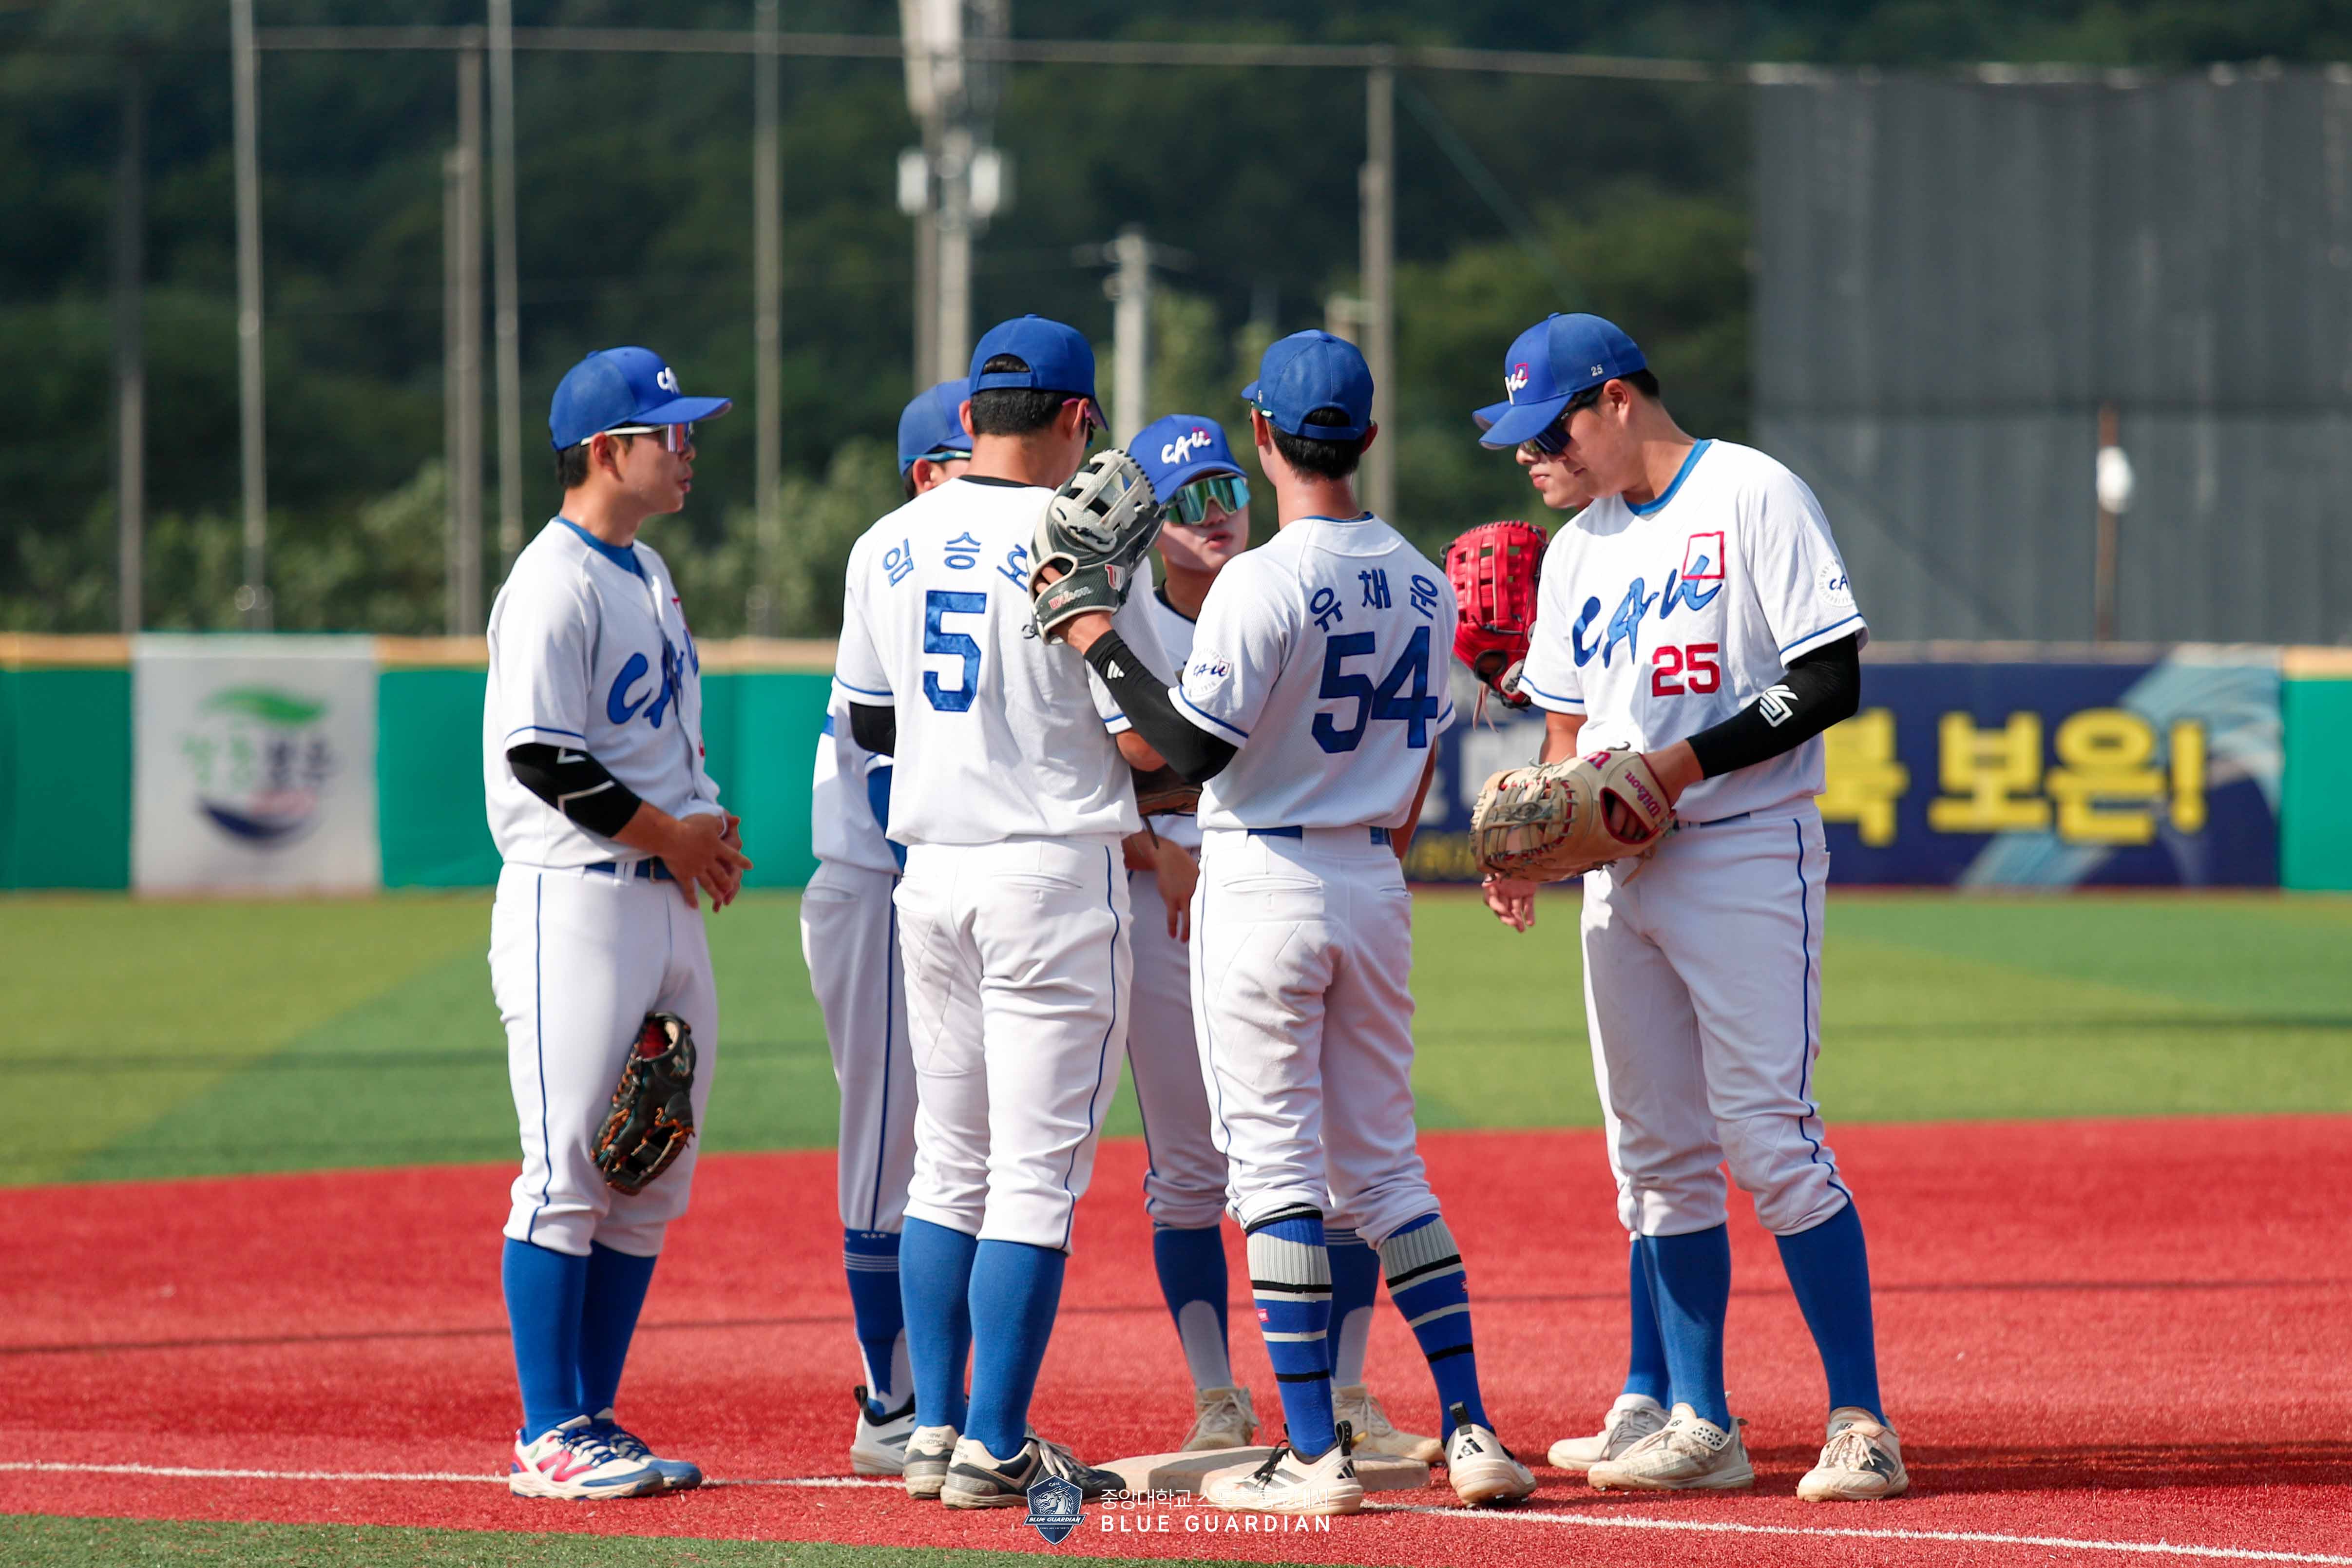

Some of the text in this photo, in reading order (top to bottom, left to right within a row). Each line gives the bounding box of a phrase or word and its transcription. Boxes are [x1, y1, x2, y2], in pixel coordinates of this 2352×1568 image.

[923, 590, 987, 712] 5
[1311, 626, 1438, 754] 54
[1651, 642, 1721, 697] 25
[1625, 769, 1661, 819] Wilson
[1926, 706, 2208, 847] 보은!
